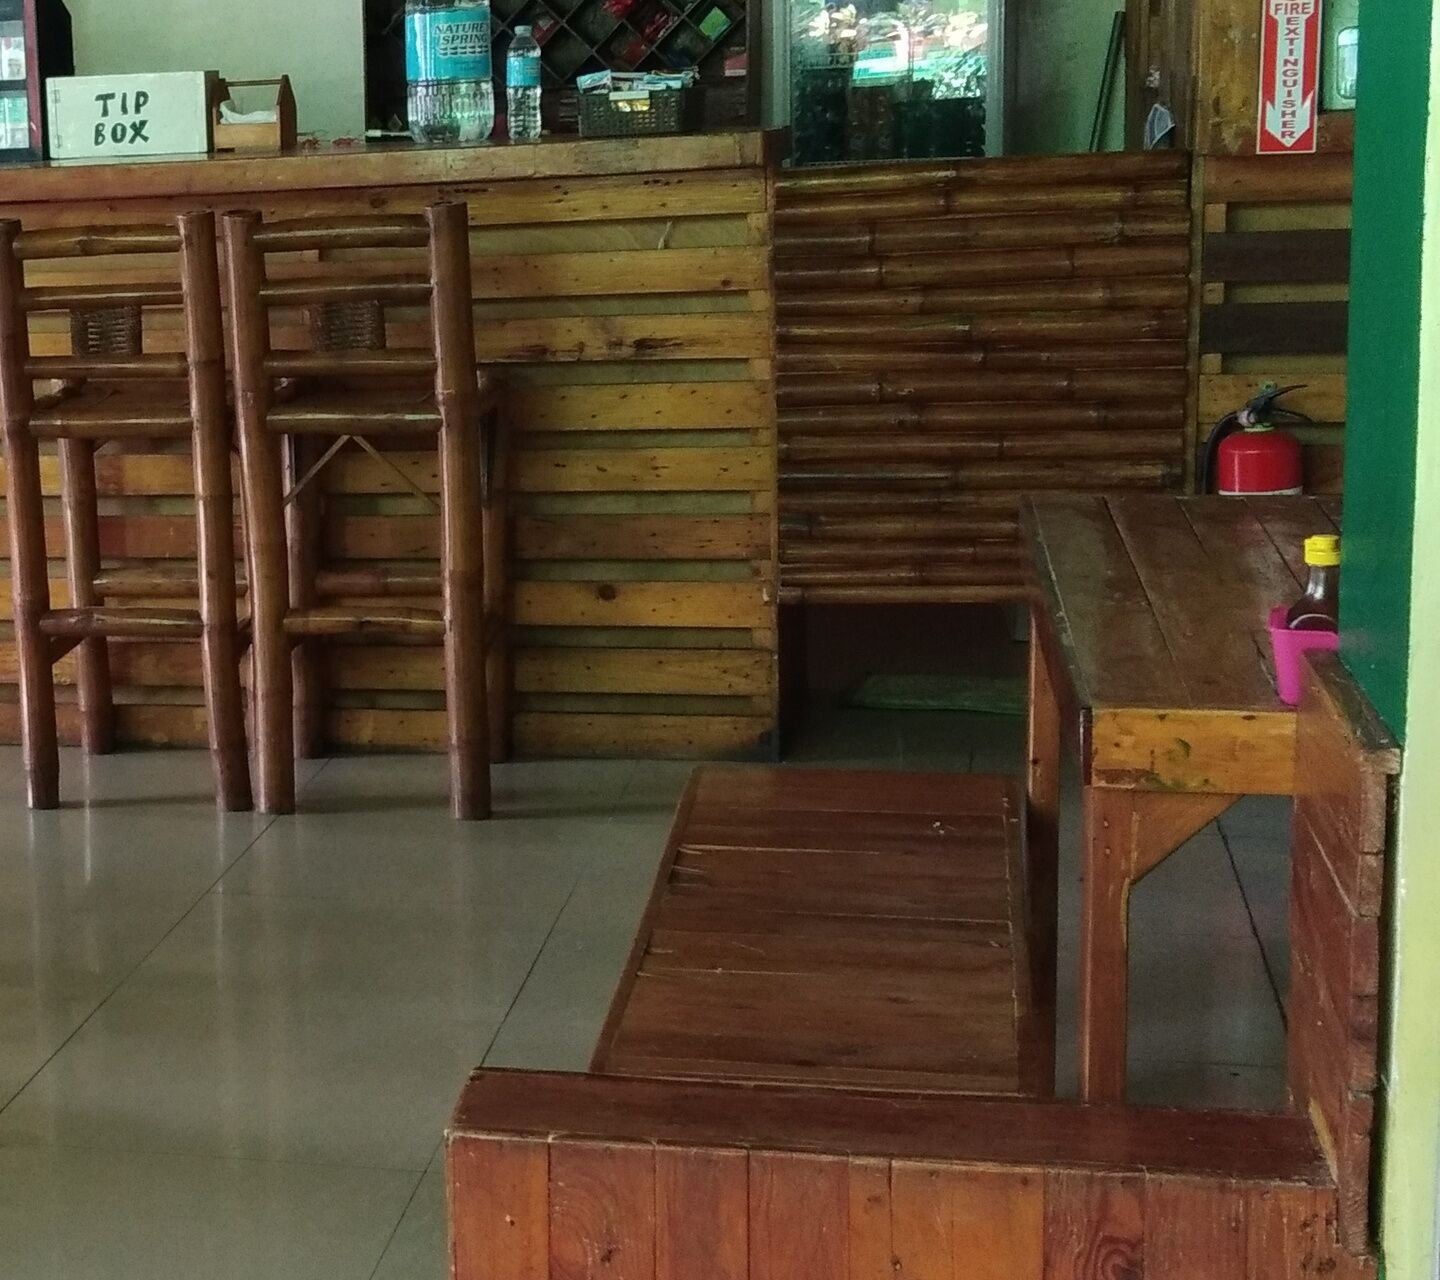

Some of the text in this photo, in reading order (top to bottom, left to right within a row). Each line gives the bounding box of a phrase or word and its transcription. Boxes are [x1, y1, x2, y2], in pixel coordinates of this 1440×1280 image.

[1274, 2, 1310, 16] FIRE
[442, 33, 488, 45] SPRING
[1280, 16, 1300, 139] EXTINGUISHER
[94, 90, 150, 118] TIP
[94, 120, 150, 146] BOX
